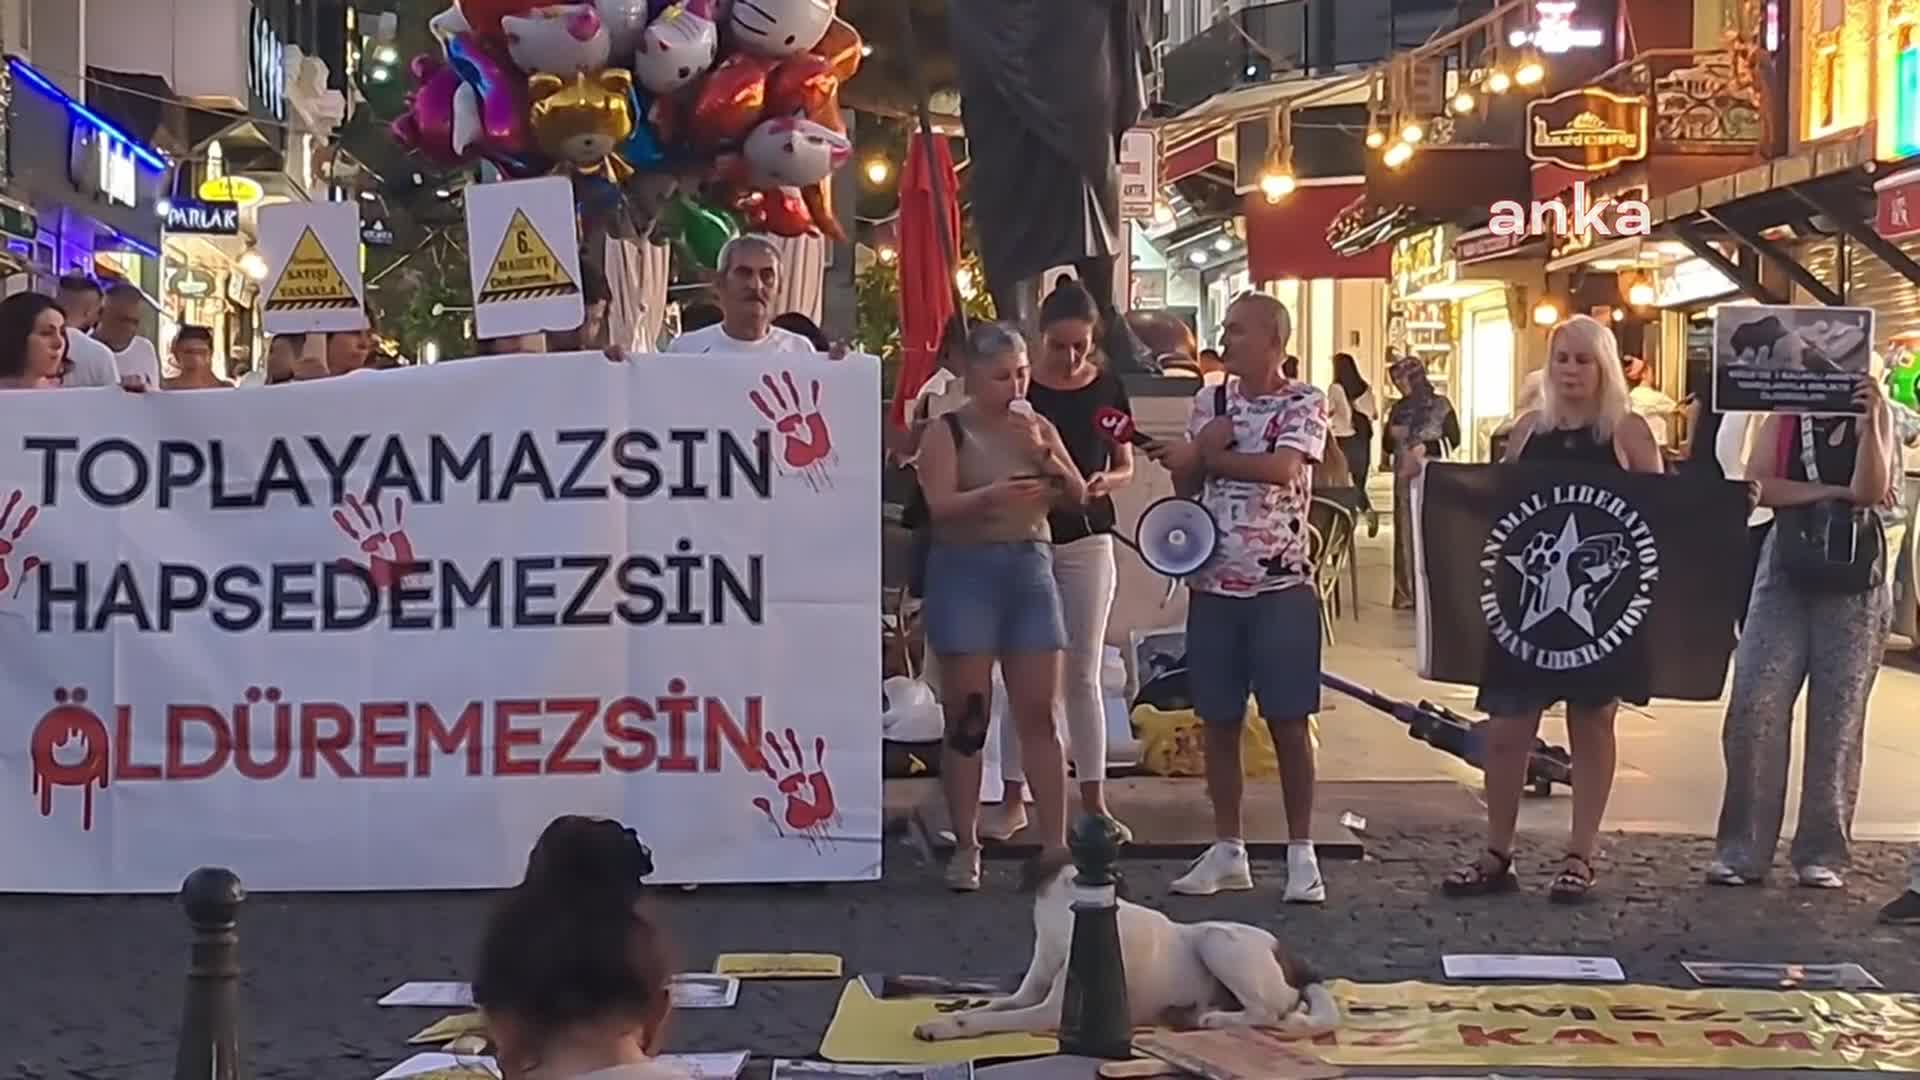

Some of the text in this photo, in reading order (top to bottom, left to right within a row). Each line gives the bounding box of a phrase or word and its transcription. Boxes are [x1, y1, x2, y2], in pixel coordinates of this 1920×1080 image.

[167, 206, 238, 230] PARLAK
[23, 428, 774, 510] TOPLAYAMAZSIN
[1480, 485, 1659, 581] ANIMAL LIBERATION
[34, 539, 766, 633] HAPSEDEMEZSİN
[1480, 592, 1652, 670] HUMAN LIBERATION
[29, 677, 769, 805] ÖLDÜREMEZSİN
